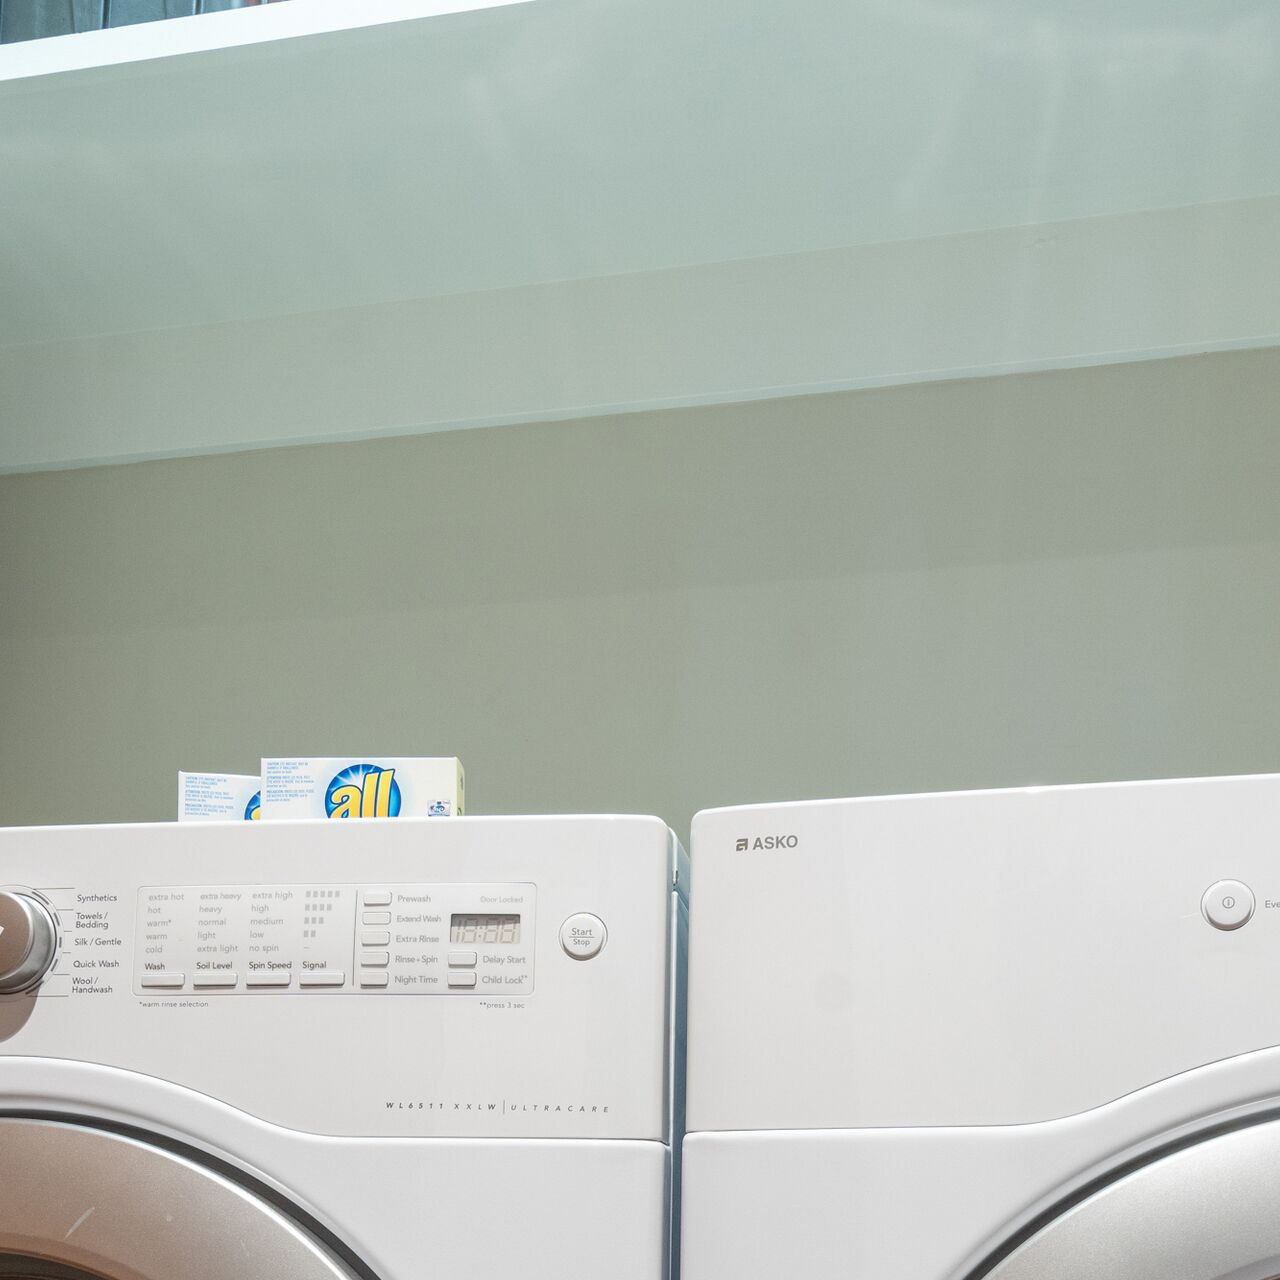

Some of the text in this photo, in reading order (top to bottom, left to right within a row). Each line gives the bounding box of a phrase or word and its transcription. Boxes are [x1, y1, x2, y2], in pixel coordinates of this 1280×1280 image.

[329, 768, 396, 819] all
[752, 835, 798, 850] ASKO
[76, 894, 118, 903] Synthetics
[148, 893, 185, 901] extra hot
[200, 892, 242, 901] extra heavy
[252, 891, 293, 900] extra high
[397, 895, 432, 903] Prewash
[498, 895, 524, 904] Locked
[147, 906, 161, 914] hot
[199, 905, 223, 914] heavy
[251, 904, 270, 913] high
[76, 912, 103, 920] Towels
[396, 914, 442, 923] Extend Wash
[75, 921, 109, 930] Bedding
[198, 918, 227, 926] normal
[250, 917, 284, 925] medium
[197, 931, 216, 940] light
[249, 931, 265, 939] low
[571, 927, 593, 936] Start
[74, 938, 89, 946] Silk
[94, 937, 122, 946] Gentle
[395, 935, 440, 943] Extra Rinse
[572, 938, 591, 946] Stop
[145, 945, 163, 954] cold
[196, 944, 239, 953] extra light
[262, 944, 280, 953] spin
[73, 960, 120, 968] Quick Wash
[394, 955, 438, 965] Rinse Spin
[482, 955, 526, 965] Delay Start
[196, 961, 233, 970] Soil Level
[248, 960, 293, 970] Spin Speed
[302, 961, 327, 970] Signal
[72, 977, 94, 985] Wool
[394, 975, 438, 985] Night Time
[481, 975, 503, 984] Child
[72, 985, 113, 994] Handwash
[178, 1000, 209, 1008] selection
